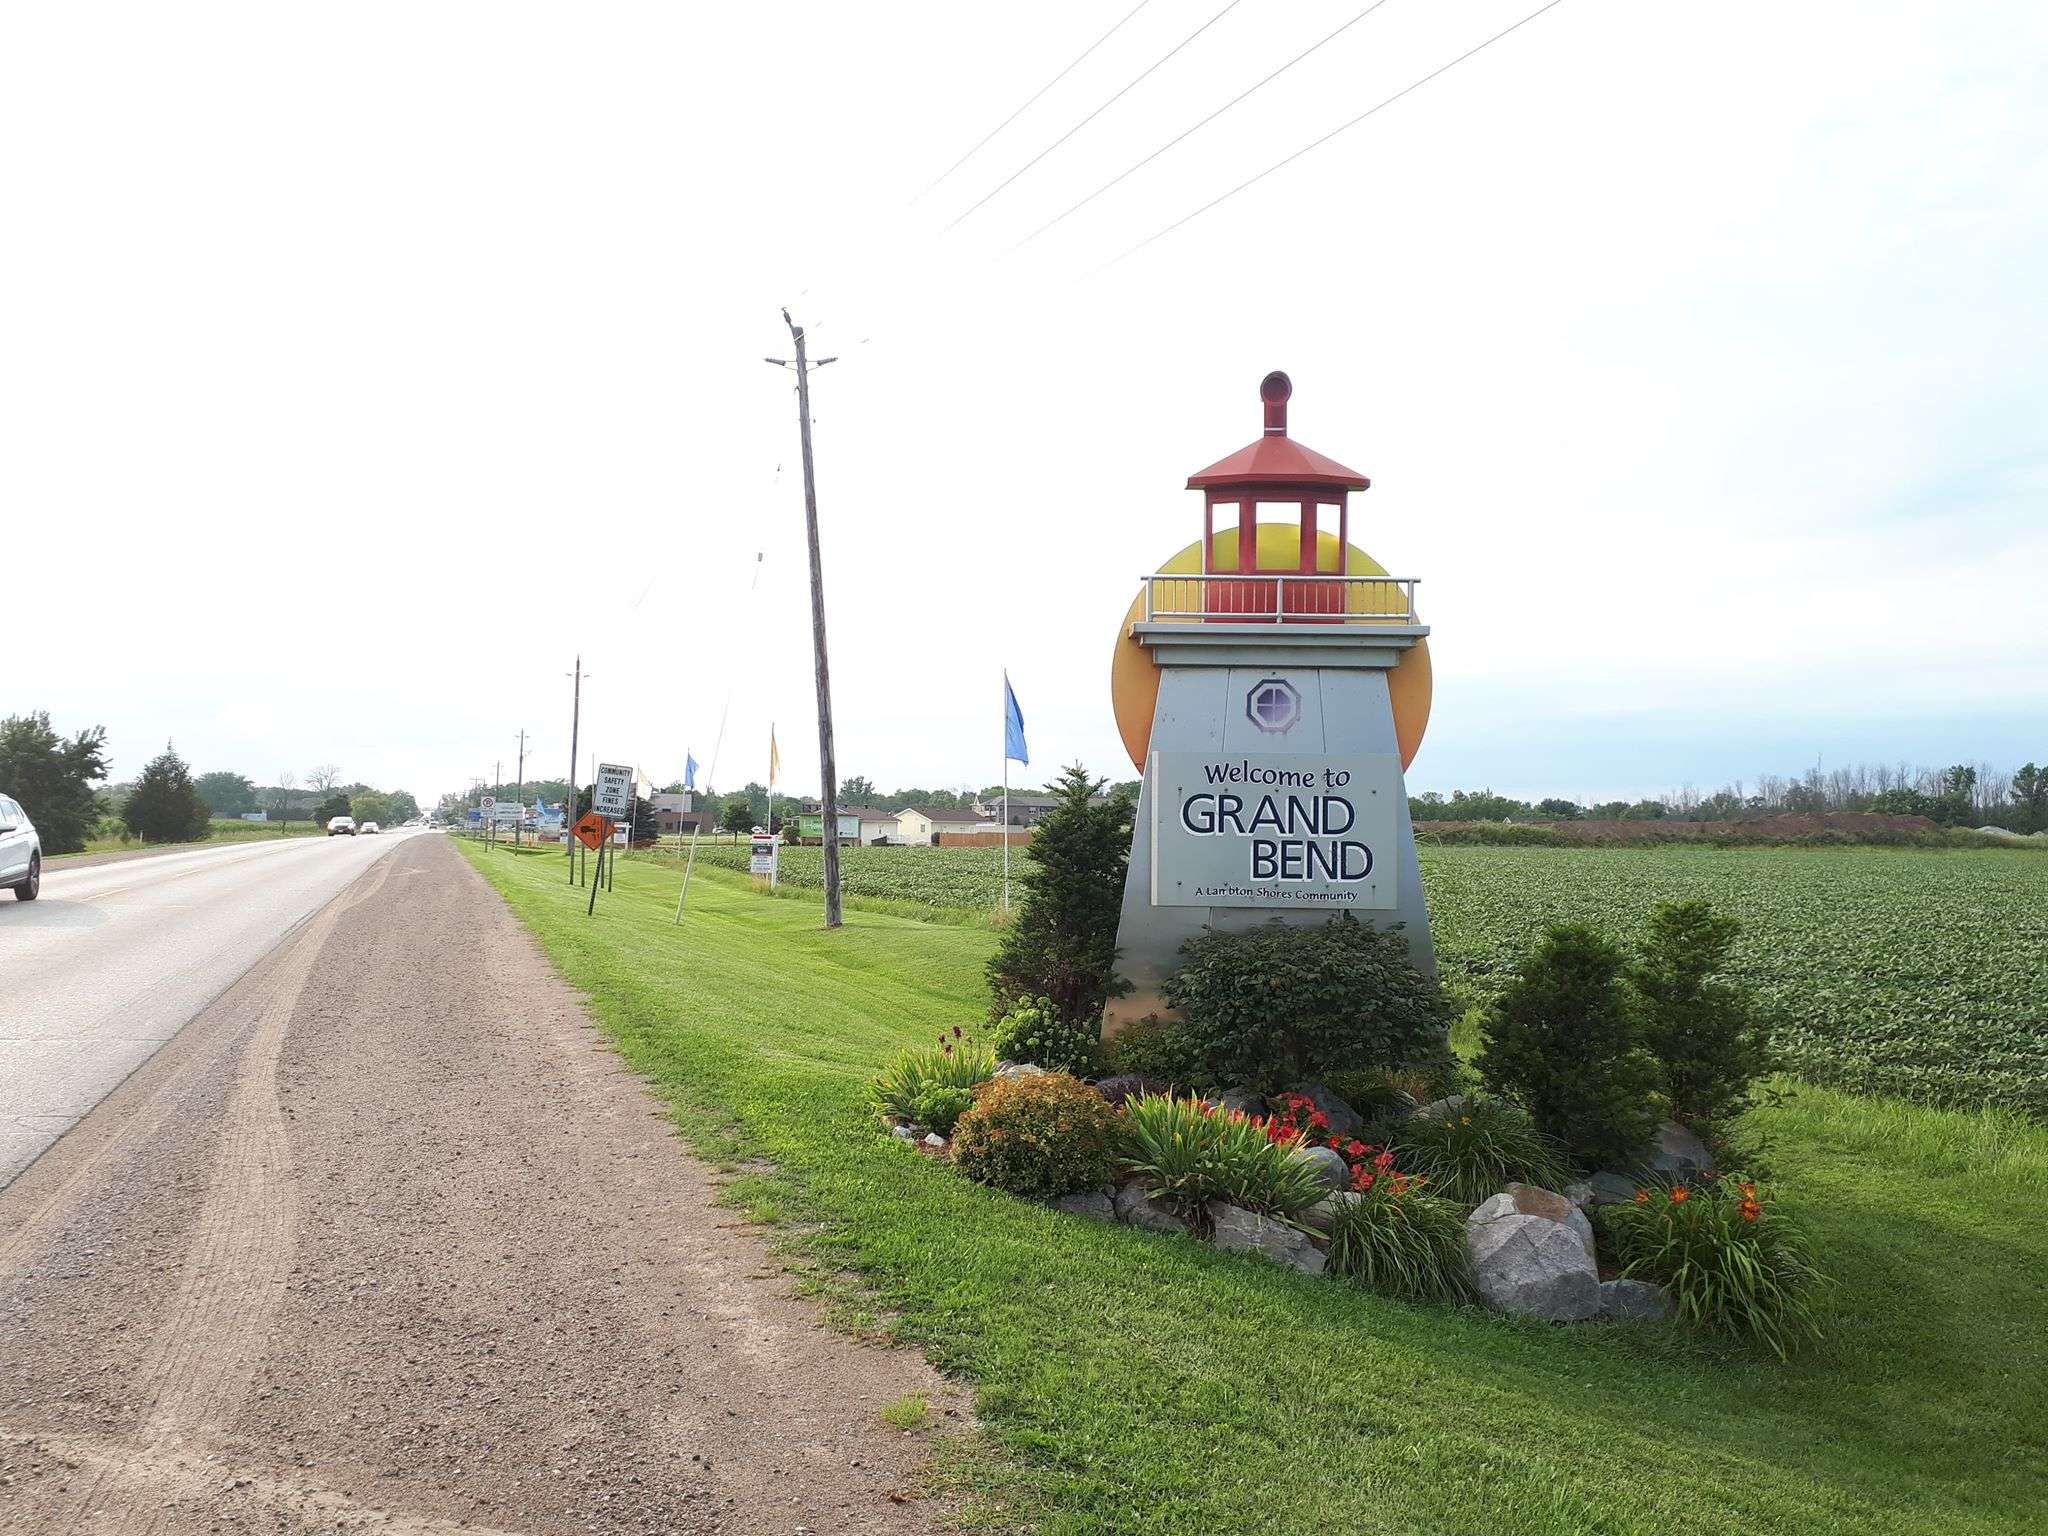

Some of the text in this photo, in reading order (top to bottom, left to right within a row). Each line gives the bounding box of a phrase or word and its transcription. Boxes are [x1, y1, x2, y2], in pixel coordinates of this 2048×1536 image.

[600, 767, 630, 777] COMMUNITY
[1204, 759, 1351, 788] Welcome to
[604, 776, 625, 785] SAFETY
[605, 786, 620, 794] ZONE
[602, 796, 619, 805] FINES
[1181, 793, 1356, 837] GRAND
[1251, 839, 1374, 882] BEND
[1195, 887, 1203, 896] A
[1256, 887, 1292, 899] Shores
[1295, 890, 1358, 902] Community
